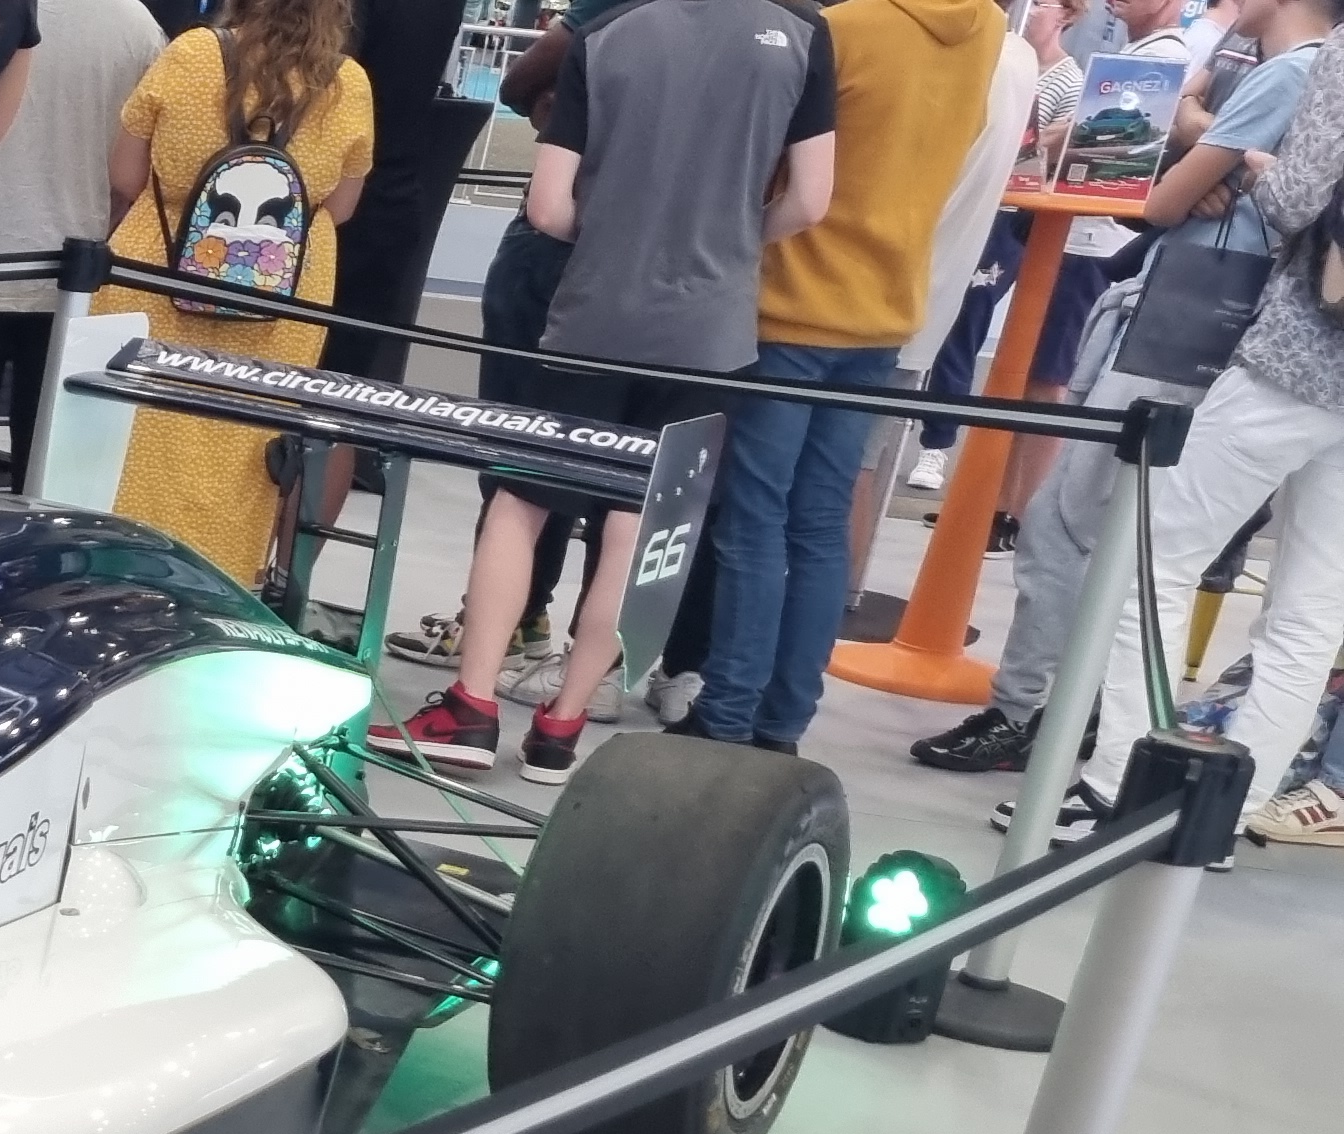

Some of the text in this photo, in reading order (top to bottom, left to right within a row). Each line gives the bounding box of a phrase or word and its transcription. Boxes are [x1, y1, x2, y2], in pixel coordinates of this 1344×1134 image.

[1100, 80, 1161, 94] GAGNEZ
[156, 346, 658, 456] www.circuitdulaquais.com
[635, 523, 691, 586] 66
